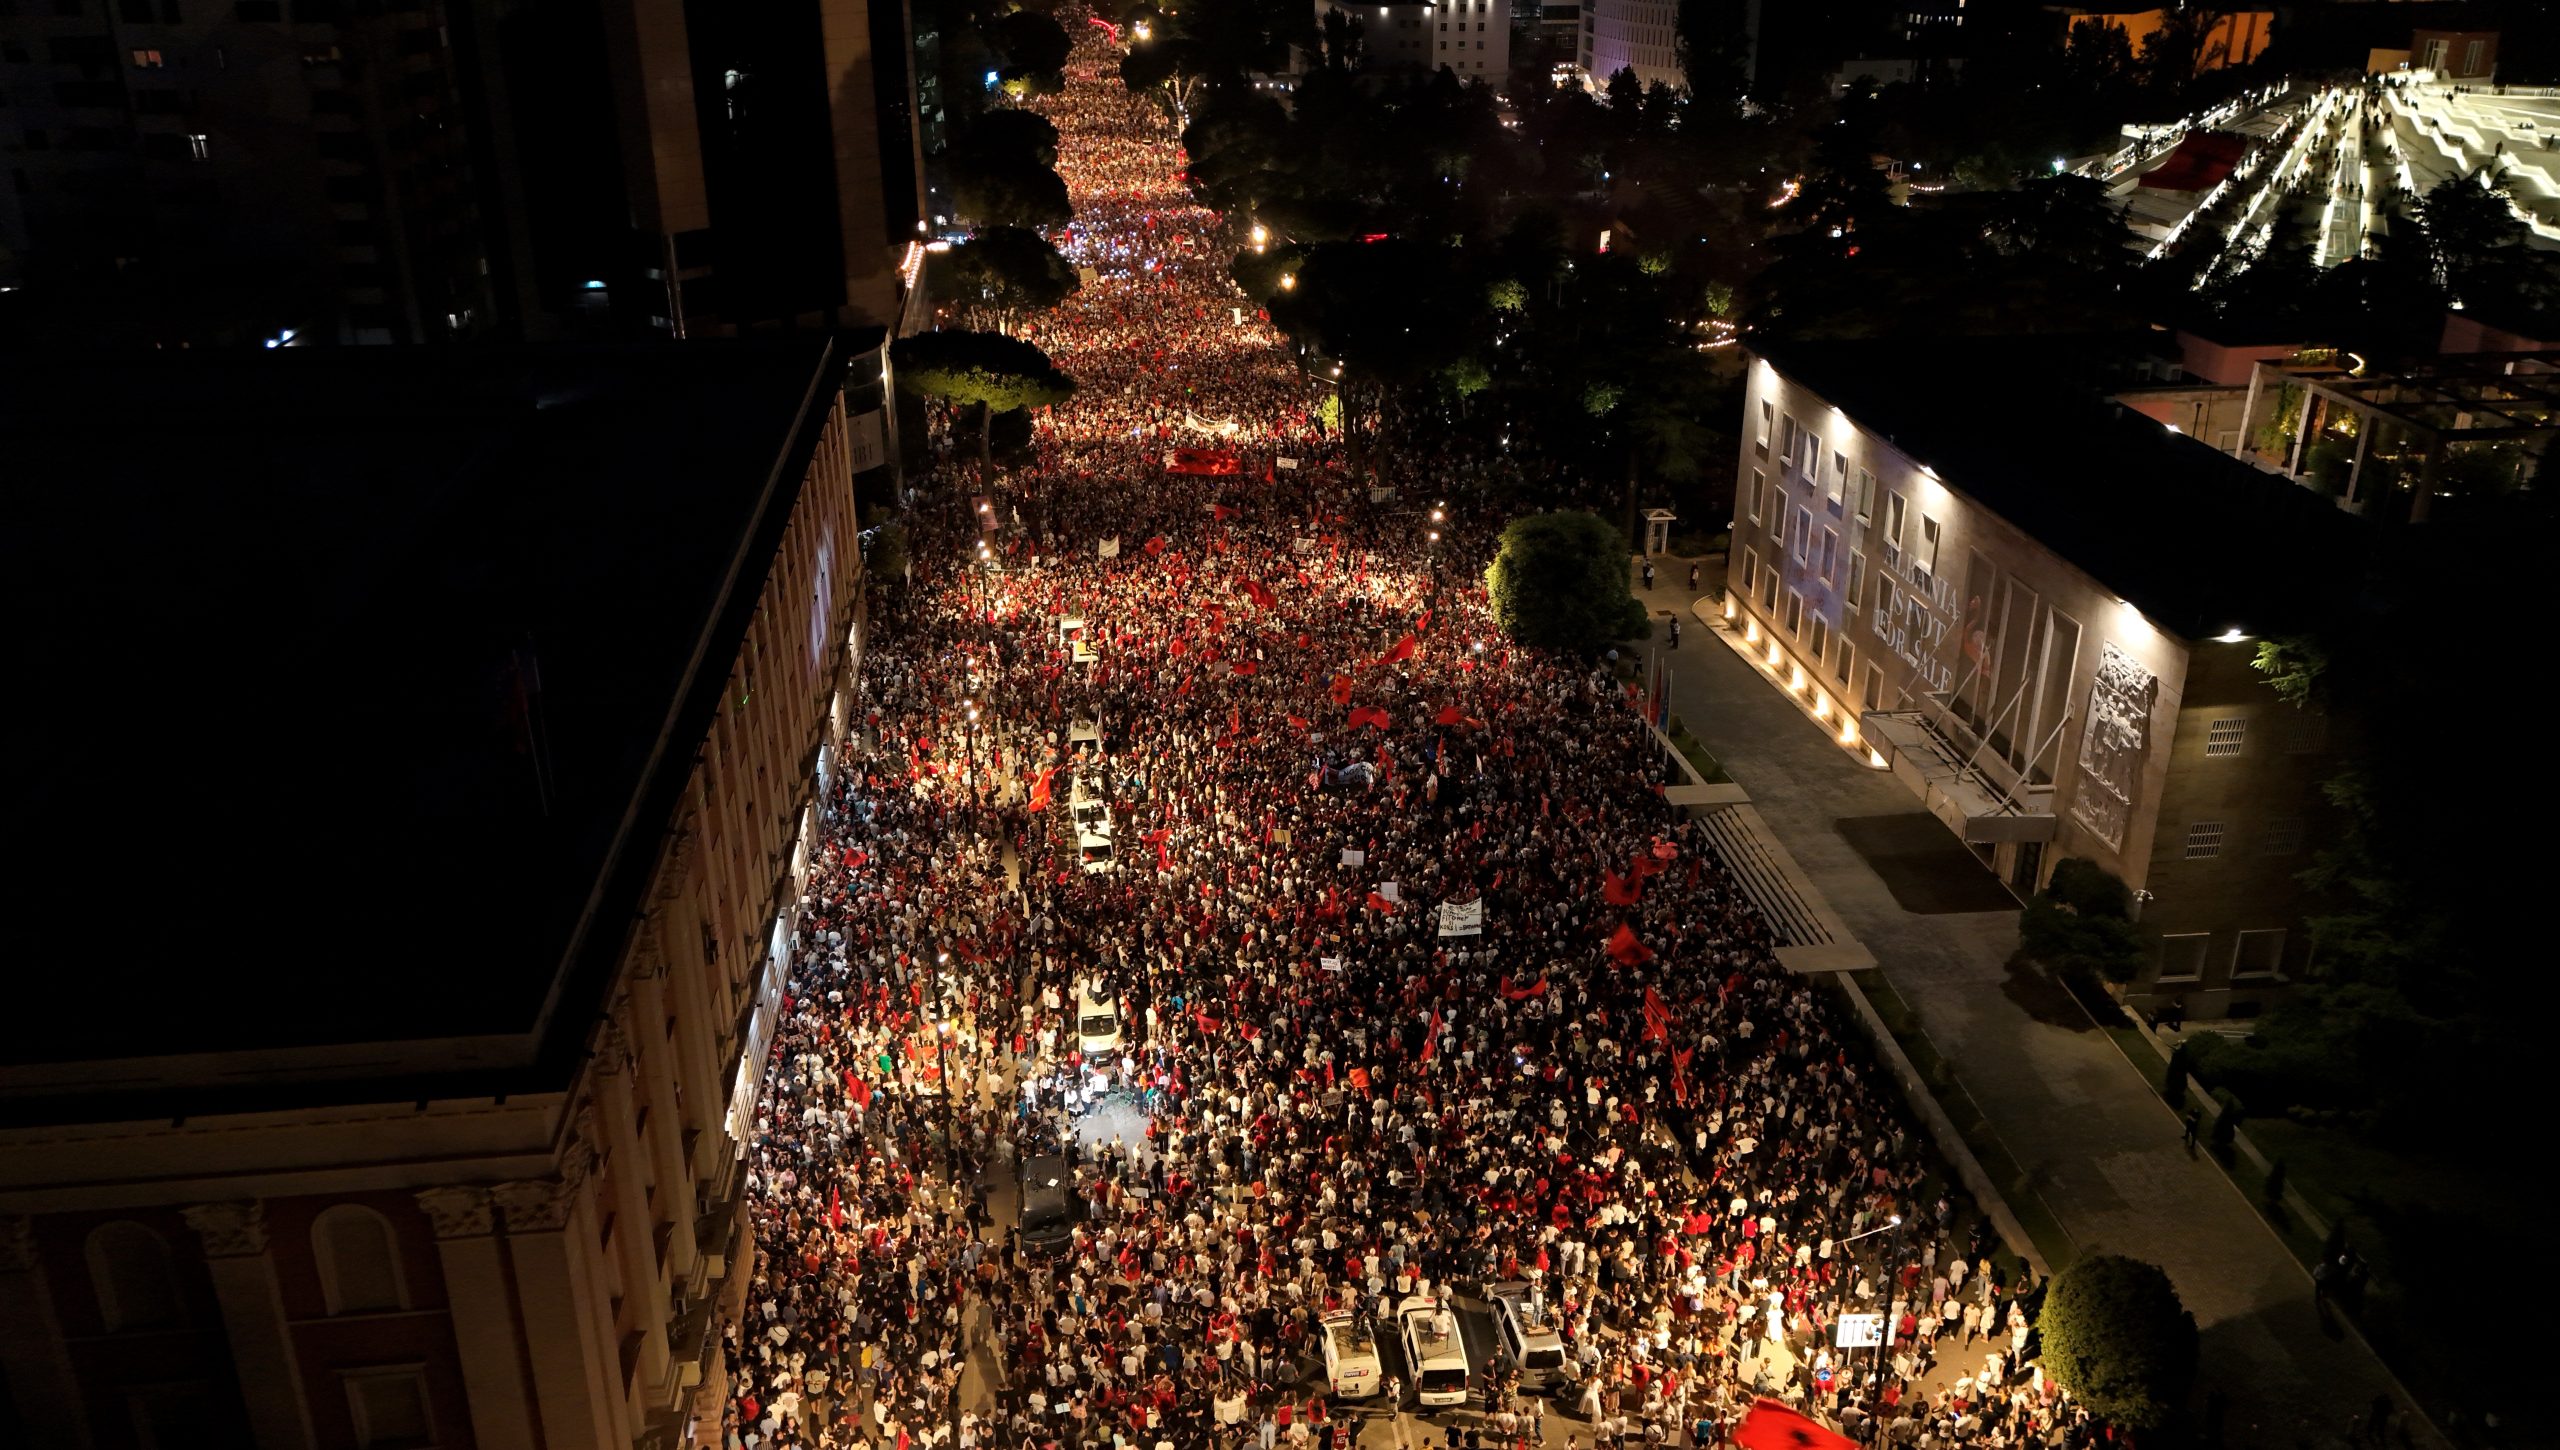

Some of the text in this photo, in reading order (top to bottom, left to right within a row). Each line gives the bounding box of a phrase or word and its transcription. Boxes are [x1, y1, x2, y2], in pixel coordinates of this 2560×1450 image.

[1883, 545, 1959, 619] ALBANIA
[1878, 608, 1953, 692] FOR SALE
[1906, 597, 1947, 648] NOT
